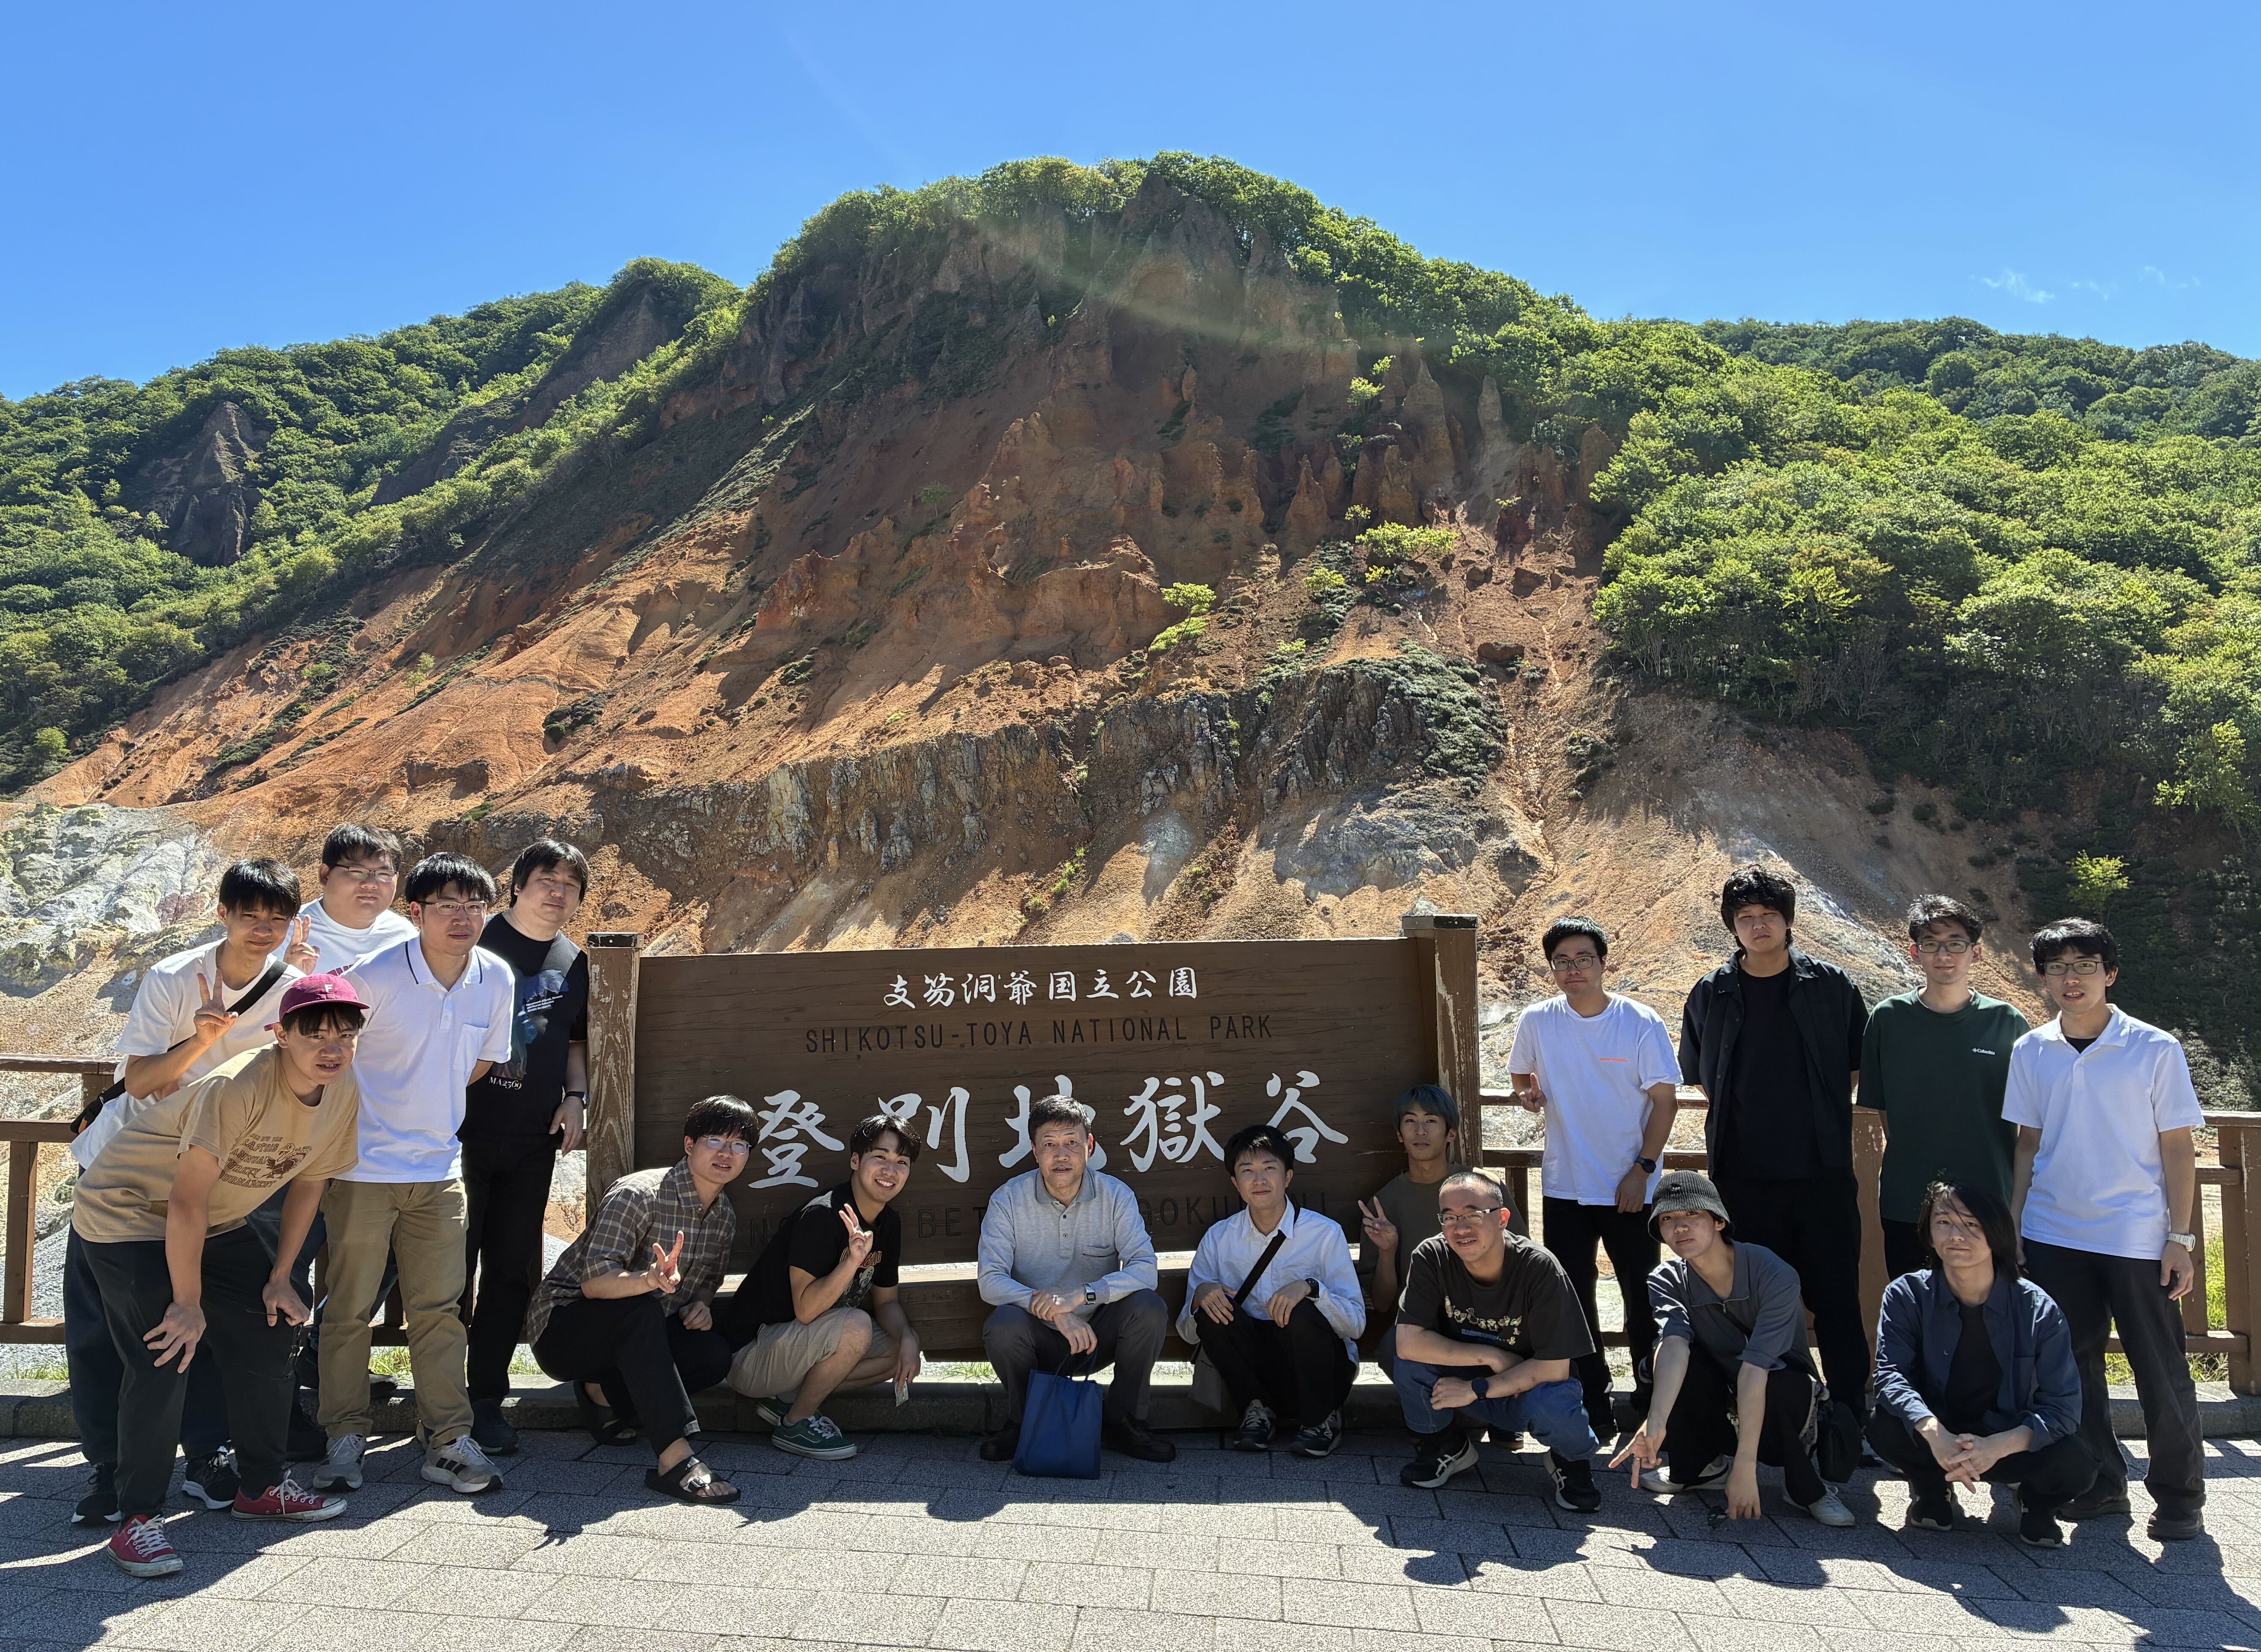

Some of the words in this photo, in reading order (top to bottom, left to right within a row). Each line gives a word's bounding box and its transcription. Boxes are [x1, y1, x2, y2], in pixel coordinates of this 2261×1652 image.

[883, 967, 1197, 1009] 支笏洞爺国立公園
[806, 1021, 1032, 1053] SHIKOTSU-TOYA
[1053, 1017, 1187, 1043] NATIONAL
[1210, 1015, 1272, 1039] PARK
